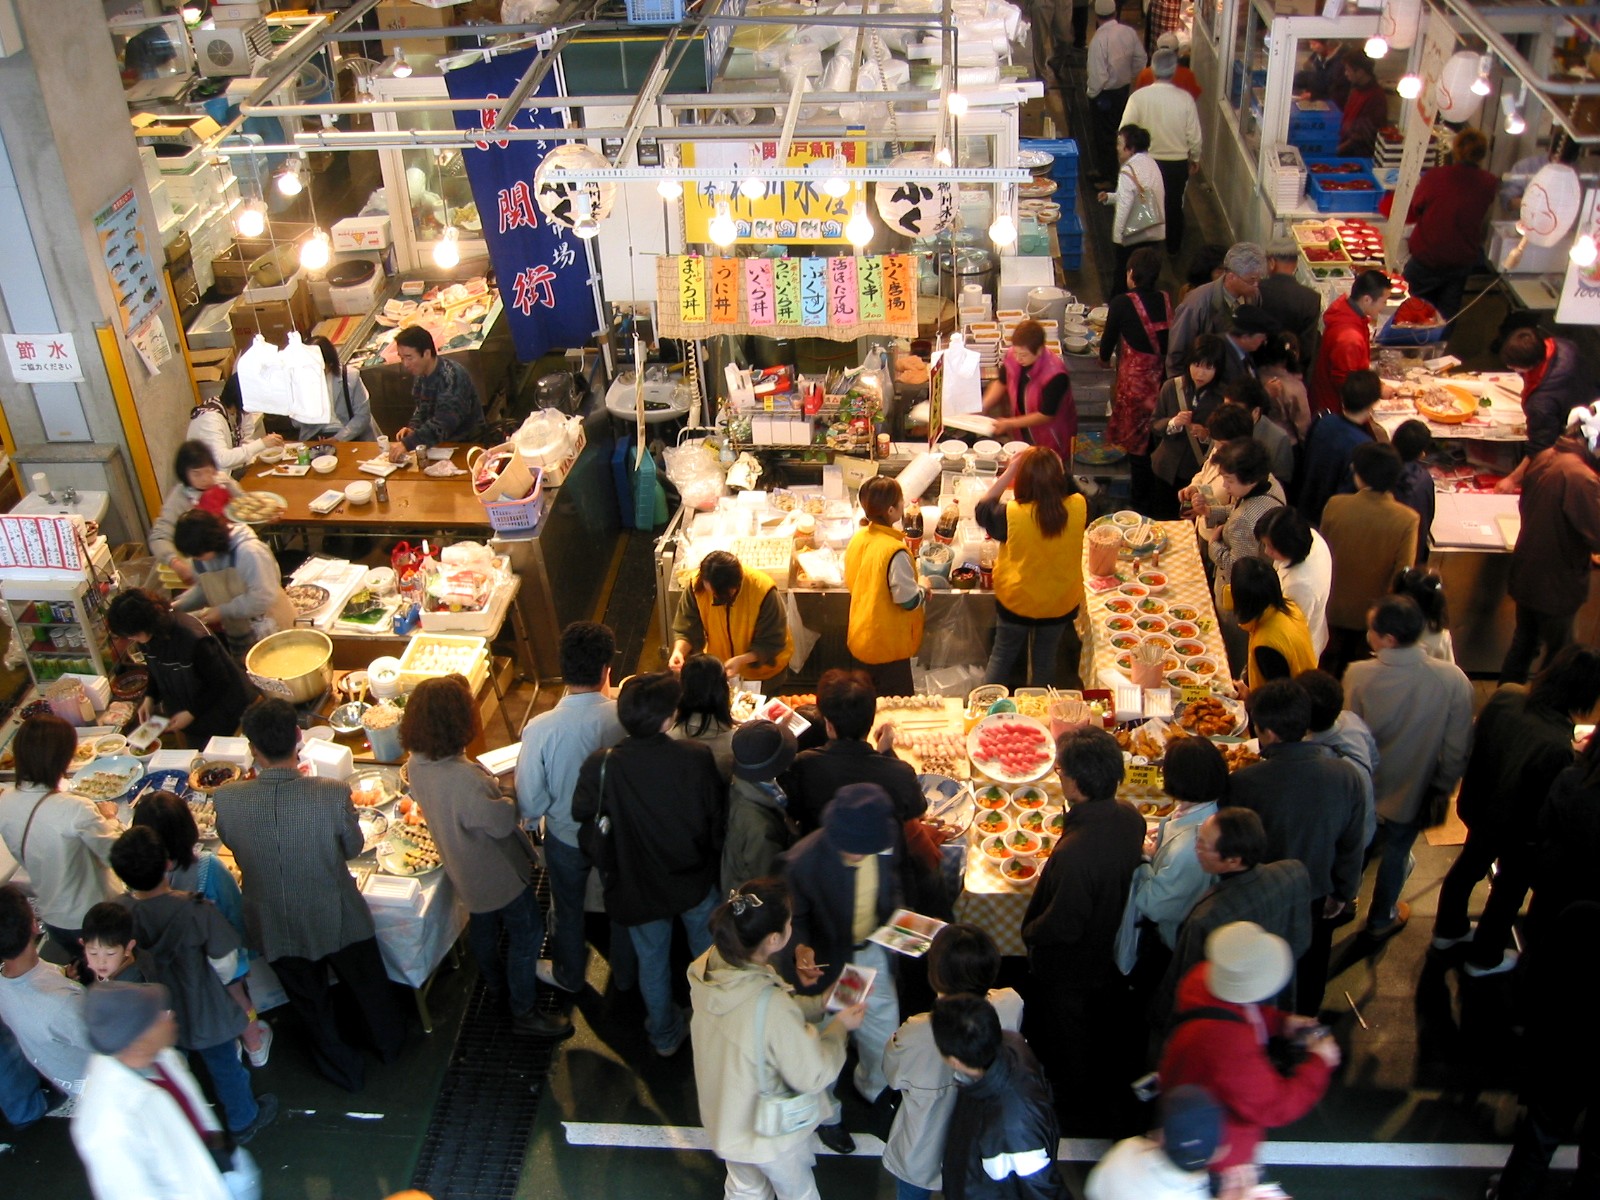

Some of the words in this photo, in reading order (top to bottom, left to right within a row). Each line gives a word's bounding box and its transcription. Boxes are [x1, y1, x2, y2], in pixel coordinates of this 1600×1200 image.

[682, 258, 701, 316] まぐろ丼
[714, 264, 732, 316] うに丼
[749, 265, 769, 317] いくら丼
[858, 259, 880, 302] ふく串
[20, 362, 73, 372] ご協力ください
